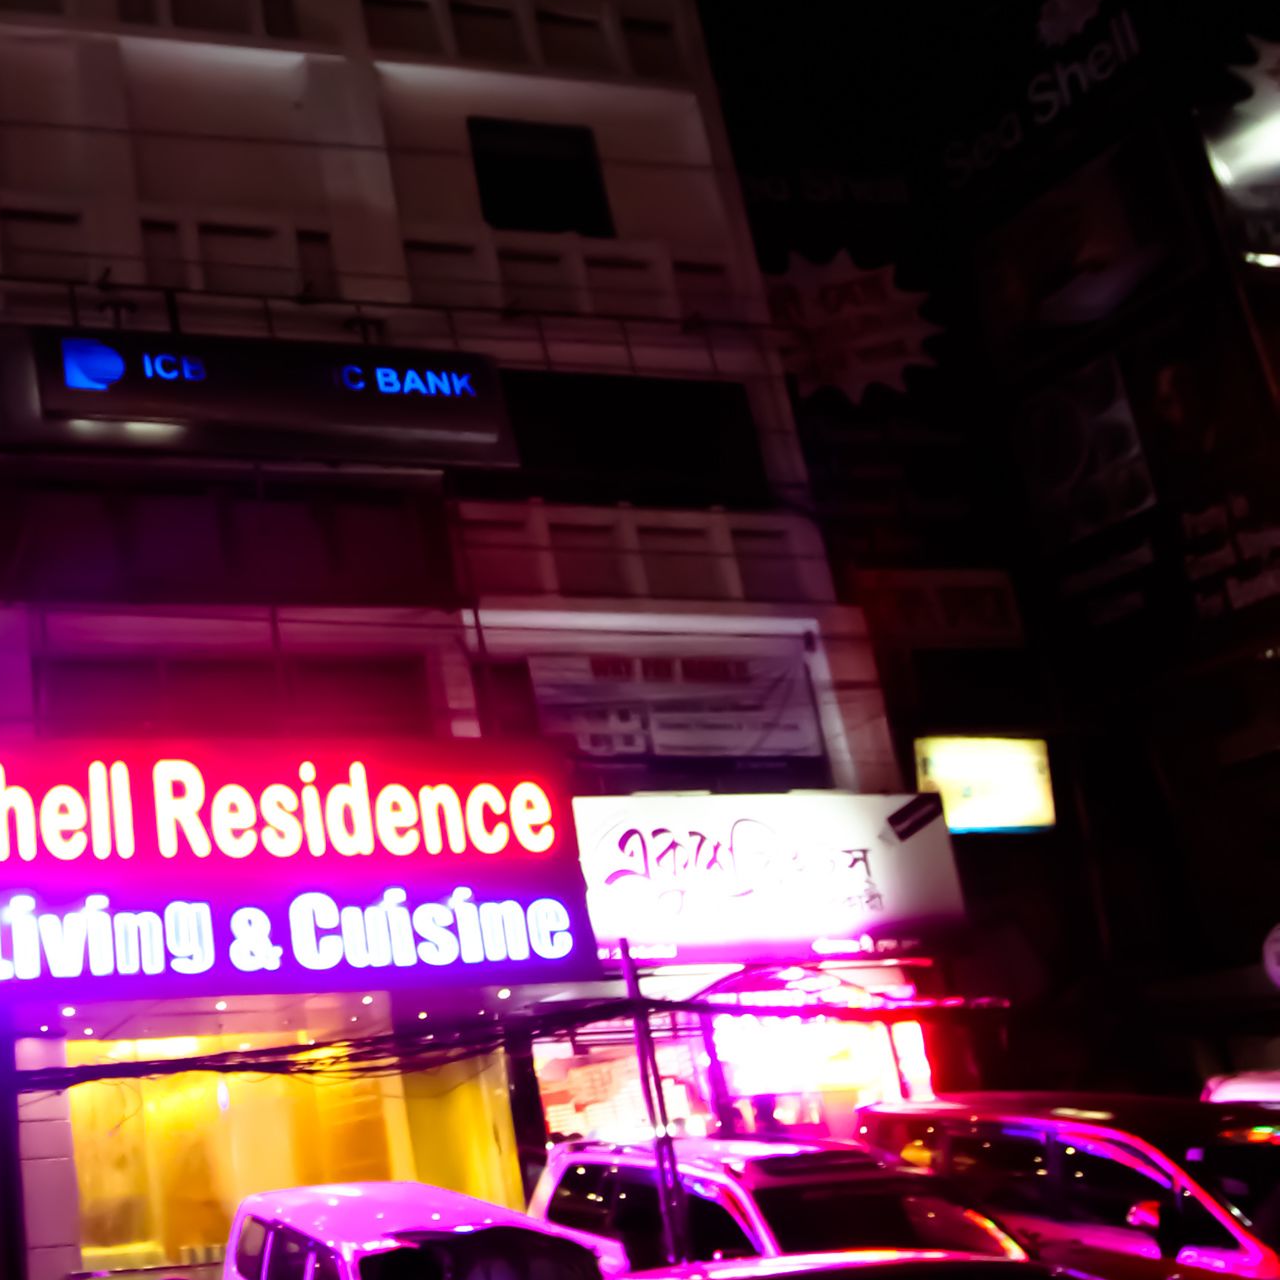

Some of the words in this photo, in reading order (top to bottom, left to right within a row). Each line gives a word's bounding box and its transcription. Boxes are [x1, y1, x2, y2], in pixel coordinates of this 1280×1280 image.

[1027, 9, 1140, 125] Shell
[375, 366, 478, 398] BANK
[153, 758, 557, 858] Residence
[230, 907, 283, 972] &
[291, 886, 574, 966] Cuisine
